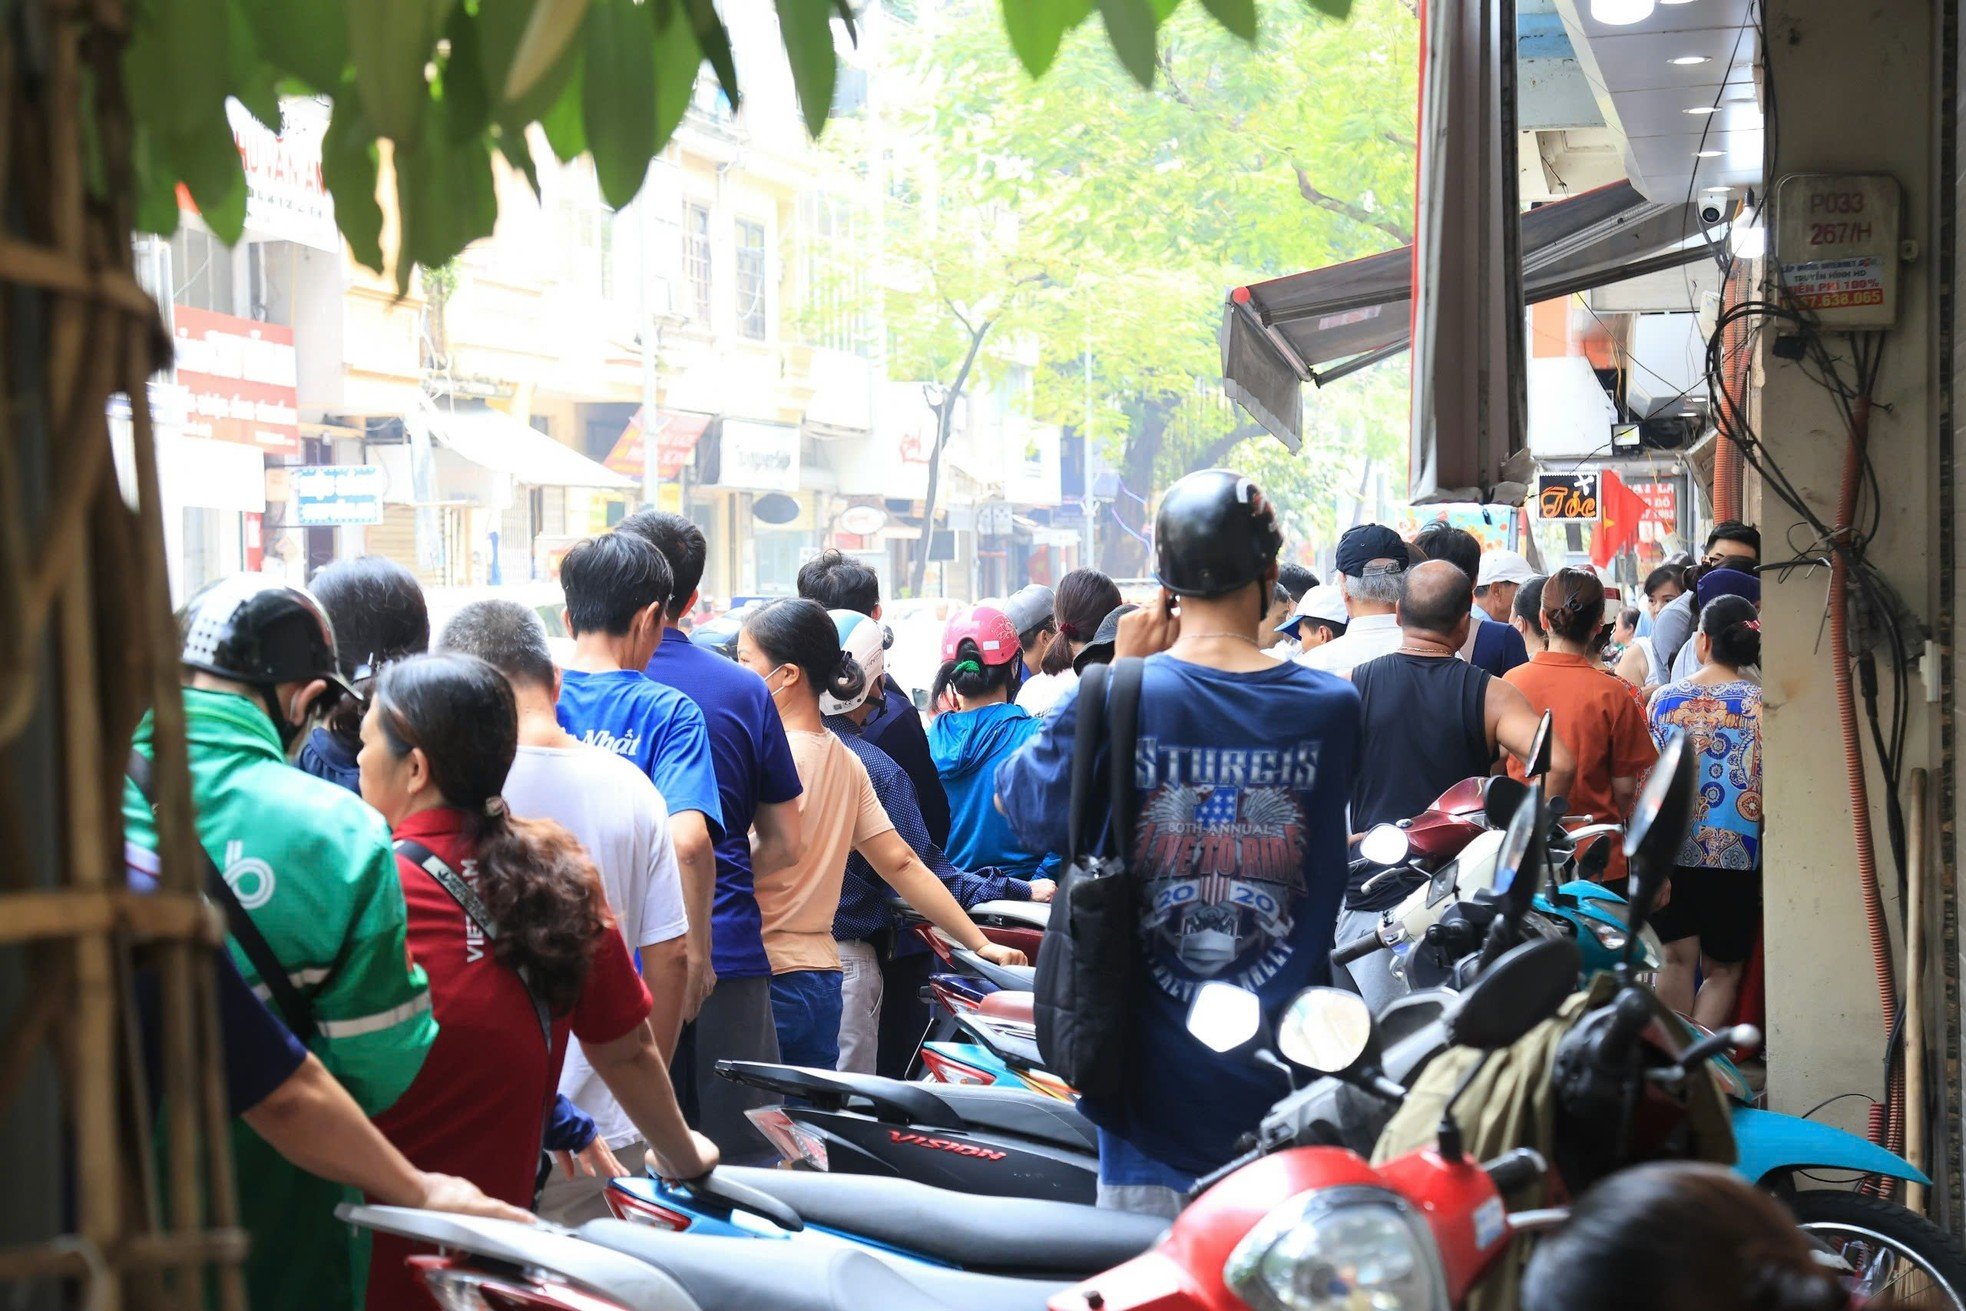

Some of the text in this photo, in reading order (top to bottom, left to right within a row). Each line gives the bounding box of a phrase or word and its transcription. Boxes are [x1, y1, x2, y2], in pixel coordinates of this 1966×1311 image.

[1810, 192, 1865, 214] P033
[1810, 221, 1872, 245] 267/H
[1135, 736, 1322, 791] STURGIS
[1156, 884, 1275, 913] 20 20
[889, 1130, 1007, 1161] VISION
